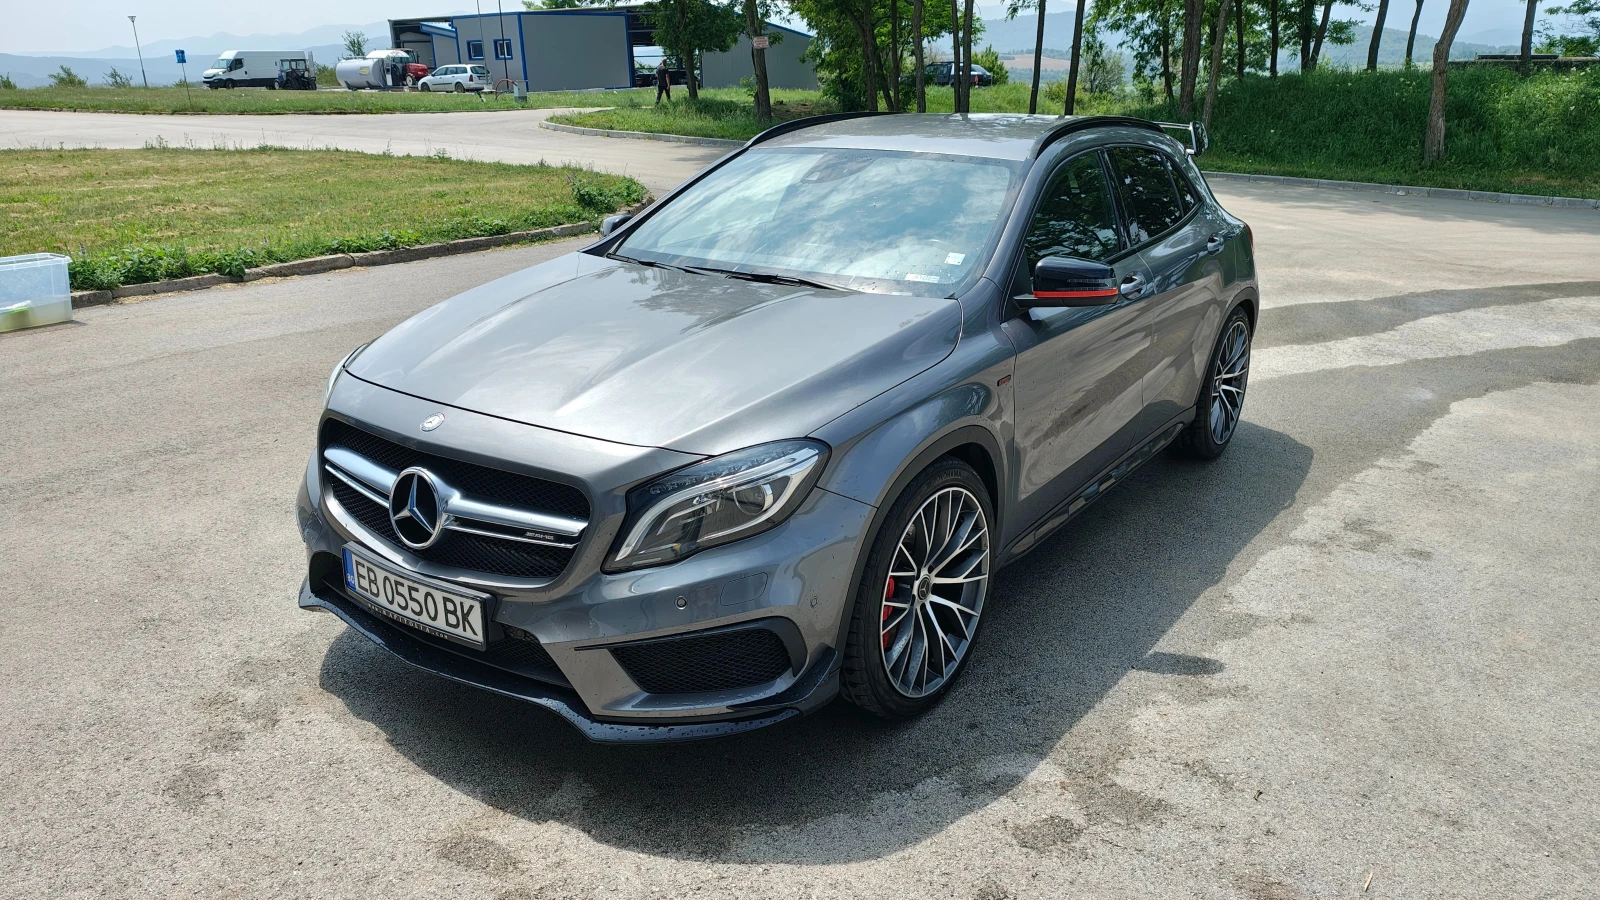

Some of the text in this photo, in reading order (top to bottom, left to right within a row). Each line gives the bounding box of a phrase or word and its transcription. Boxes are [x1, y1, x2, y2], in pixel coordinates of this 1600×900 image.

[531, 532, 554, 540] AMG
[355, 560, 478, 636] EB 0550 BK
